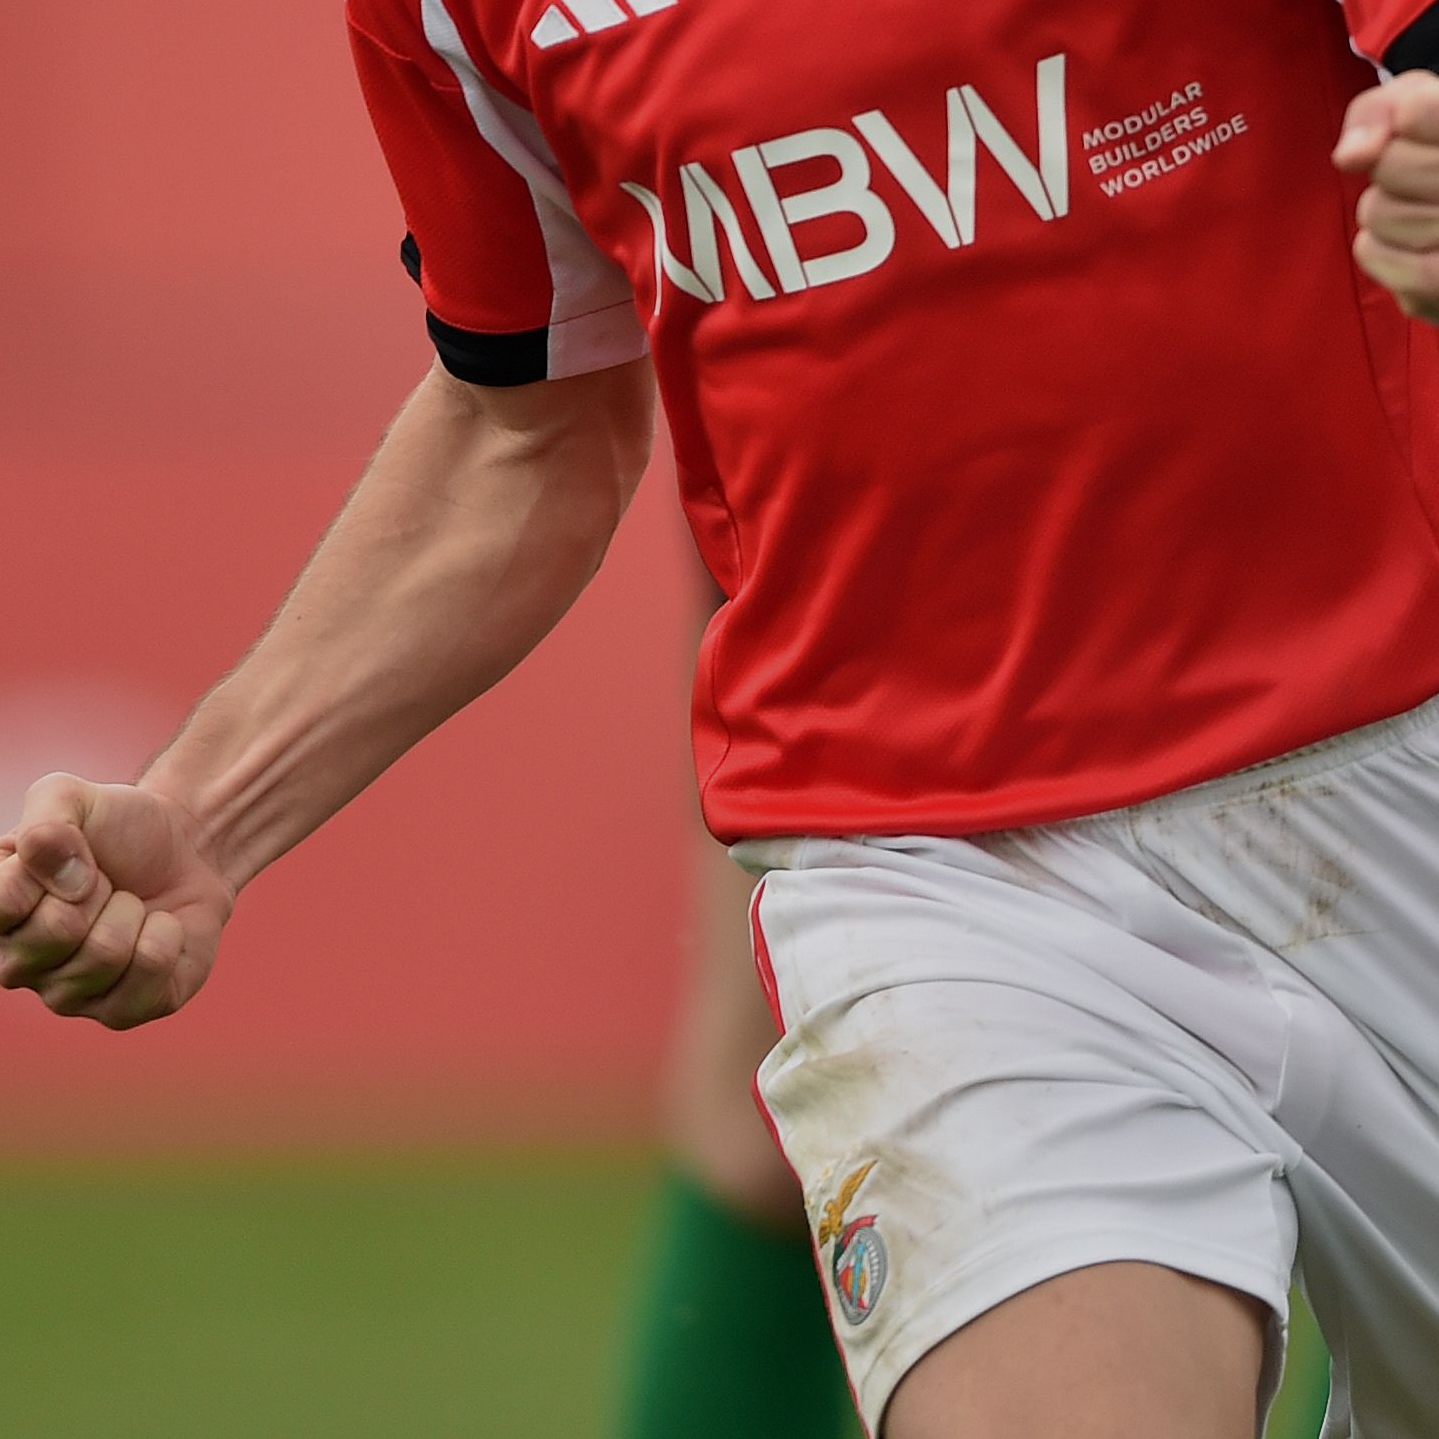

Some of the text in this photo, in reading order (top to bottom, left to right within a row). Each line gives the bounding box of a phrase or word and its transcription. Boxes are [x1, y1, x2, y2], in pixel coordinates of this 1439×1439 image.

[1082, 81, 1203, 150] MODULAR
[1088, 106, 1209, 175] BUILDERS
[619, 52, 1069, 315] MBW
[1099, 113, 1249, 198] WORLDWIDE
